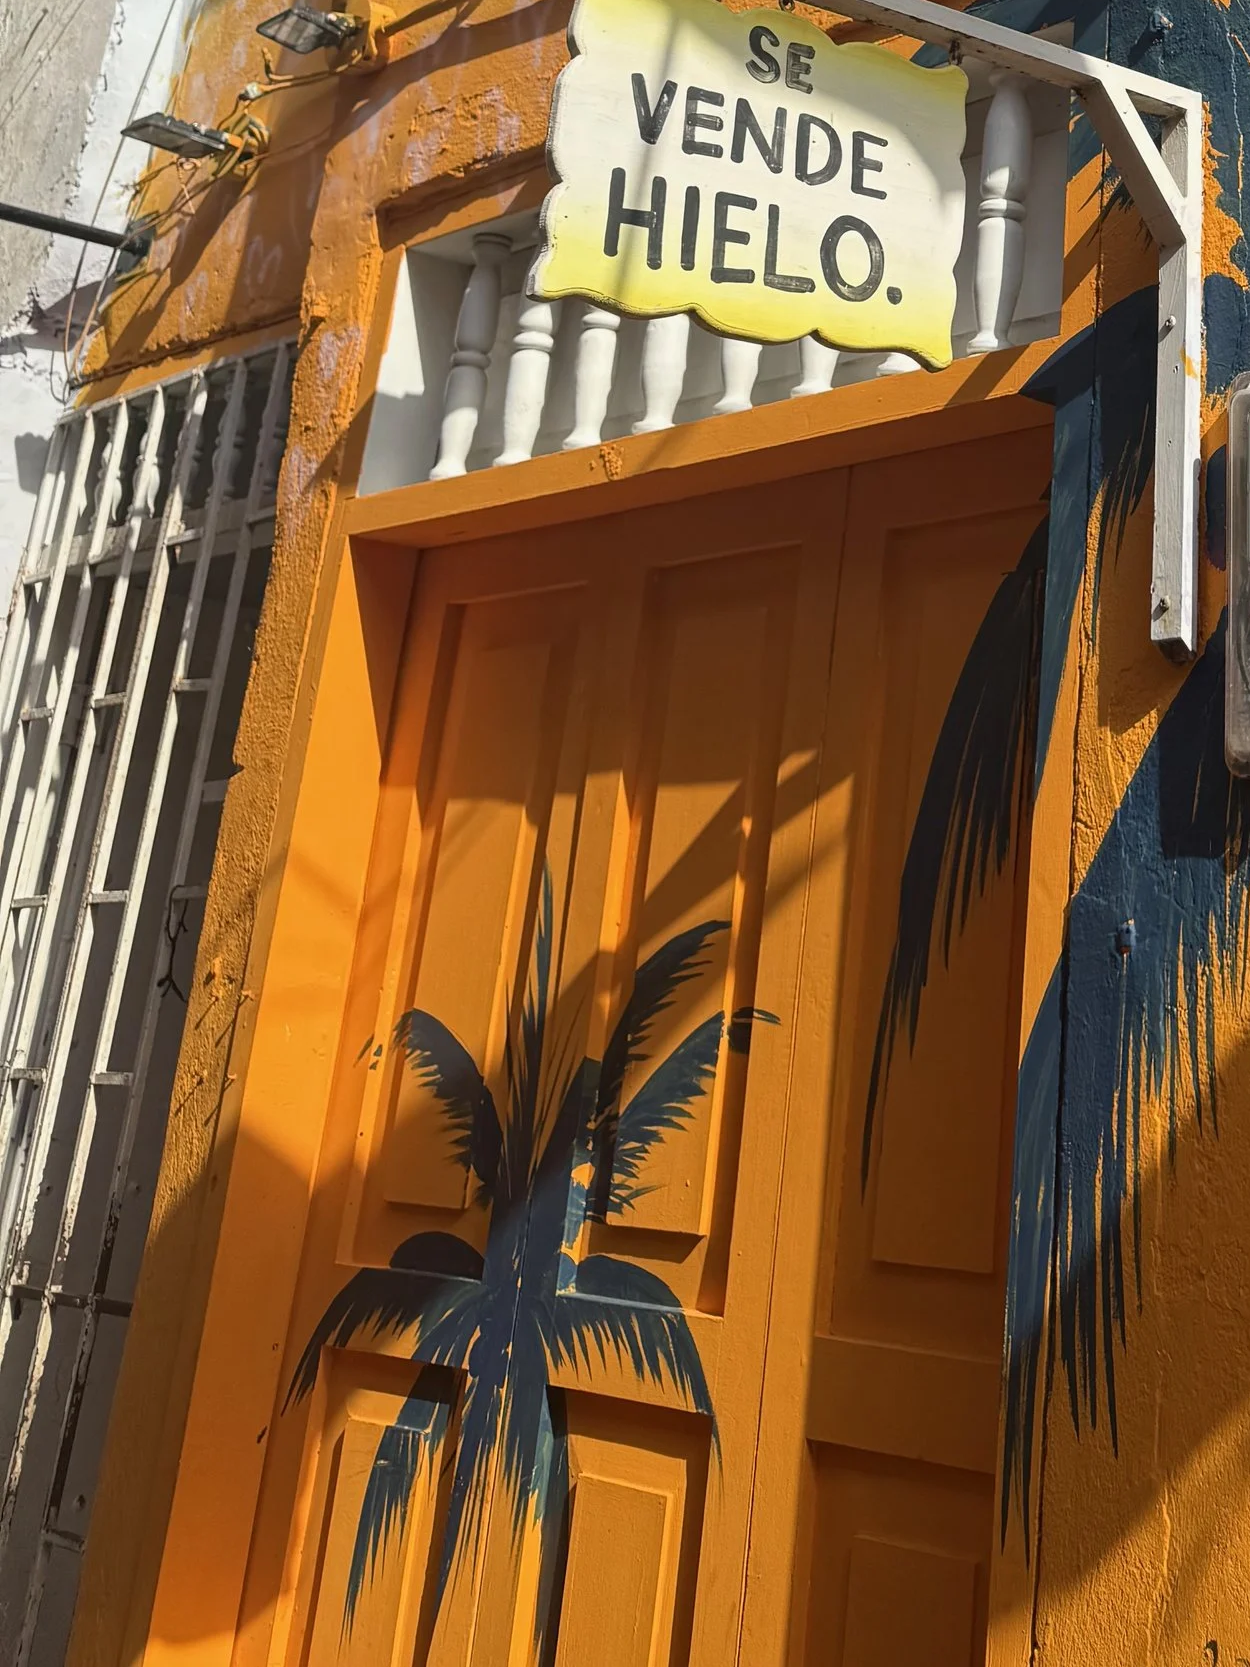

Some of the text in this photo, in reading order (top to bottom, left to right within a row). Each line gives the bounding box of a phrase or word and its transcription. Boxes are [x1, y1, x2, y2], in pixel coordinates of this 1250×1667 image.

[745, 25, 816, 95] SE
[630, 72, 889, 200] VENDE
[603, 166, 903, 305] HIELO.
